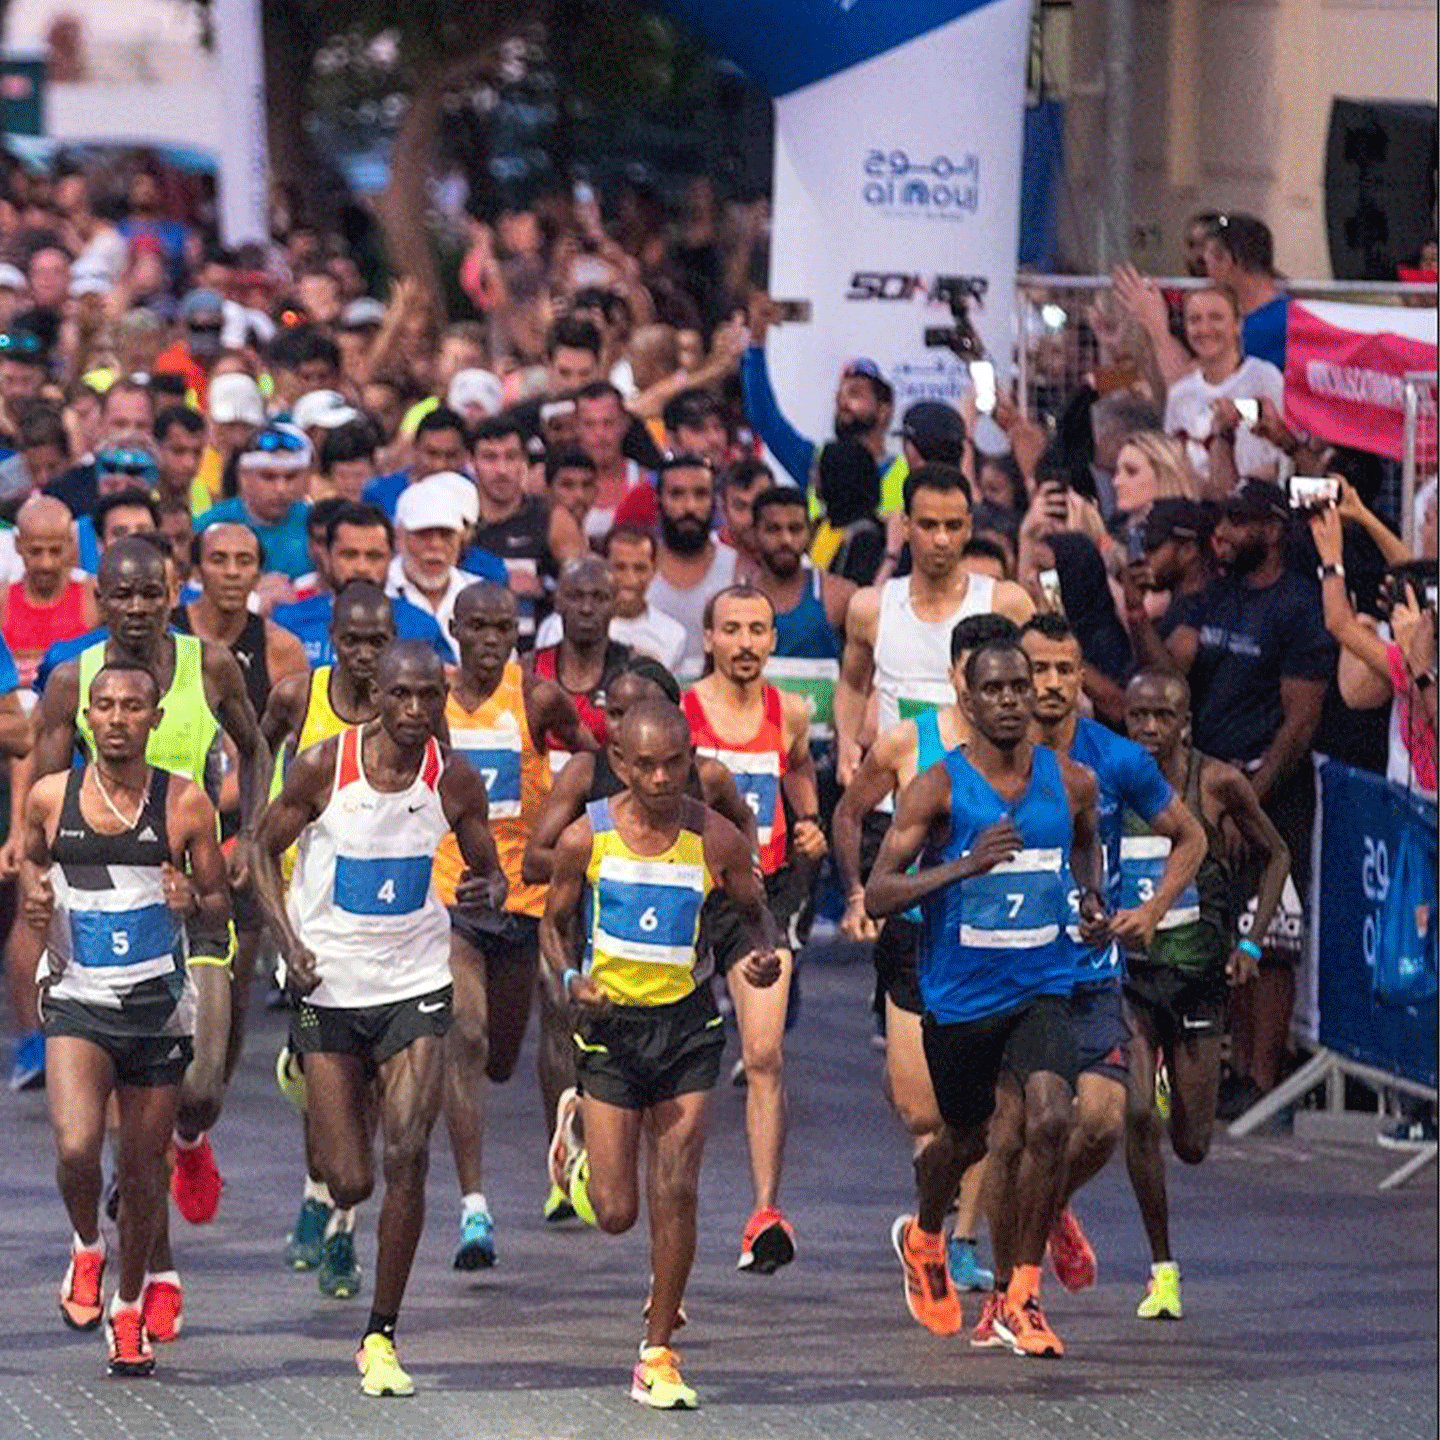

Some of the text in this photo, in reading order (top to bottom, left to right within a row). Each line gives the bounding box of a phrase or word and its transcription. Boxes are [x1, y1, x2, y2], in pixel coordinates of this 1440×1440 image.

[377, 879, 396, 904] 4
[1137, 877, 1155, 902] 3
[1006, 892, 1025, 919] 7
[639, 906, 658, 932] 6
[111, 930, 130, 956] 5
